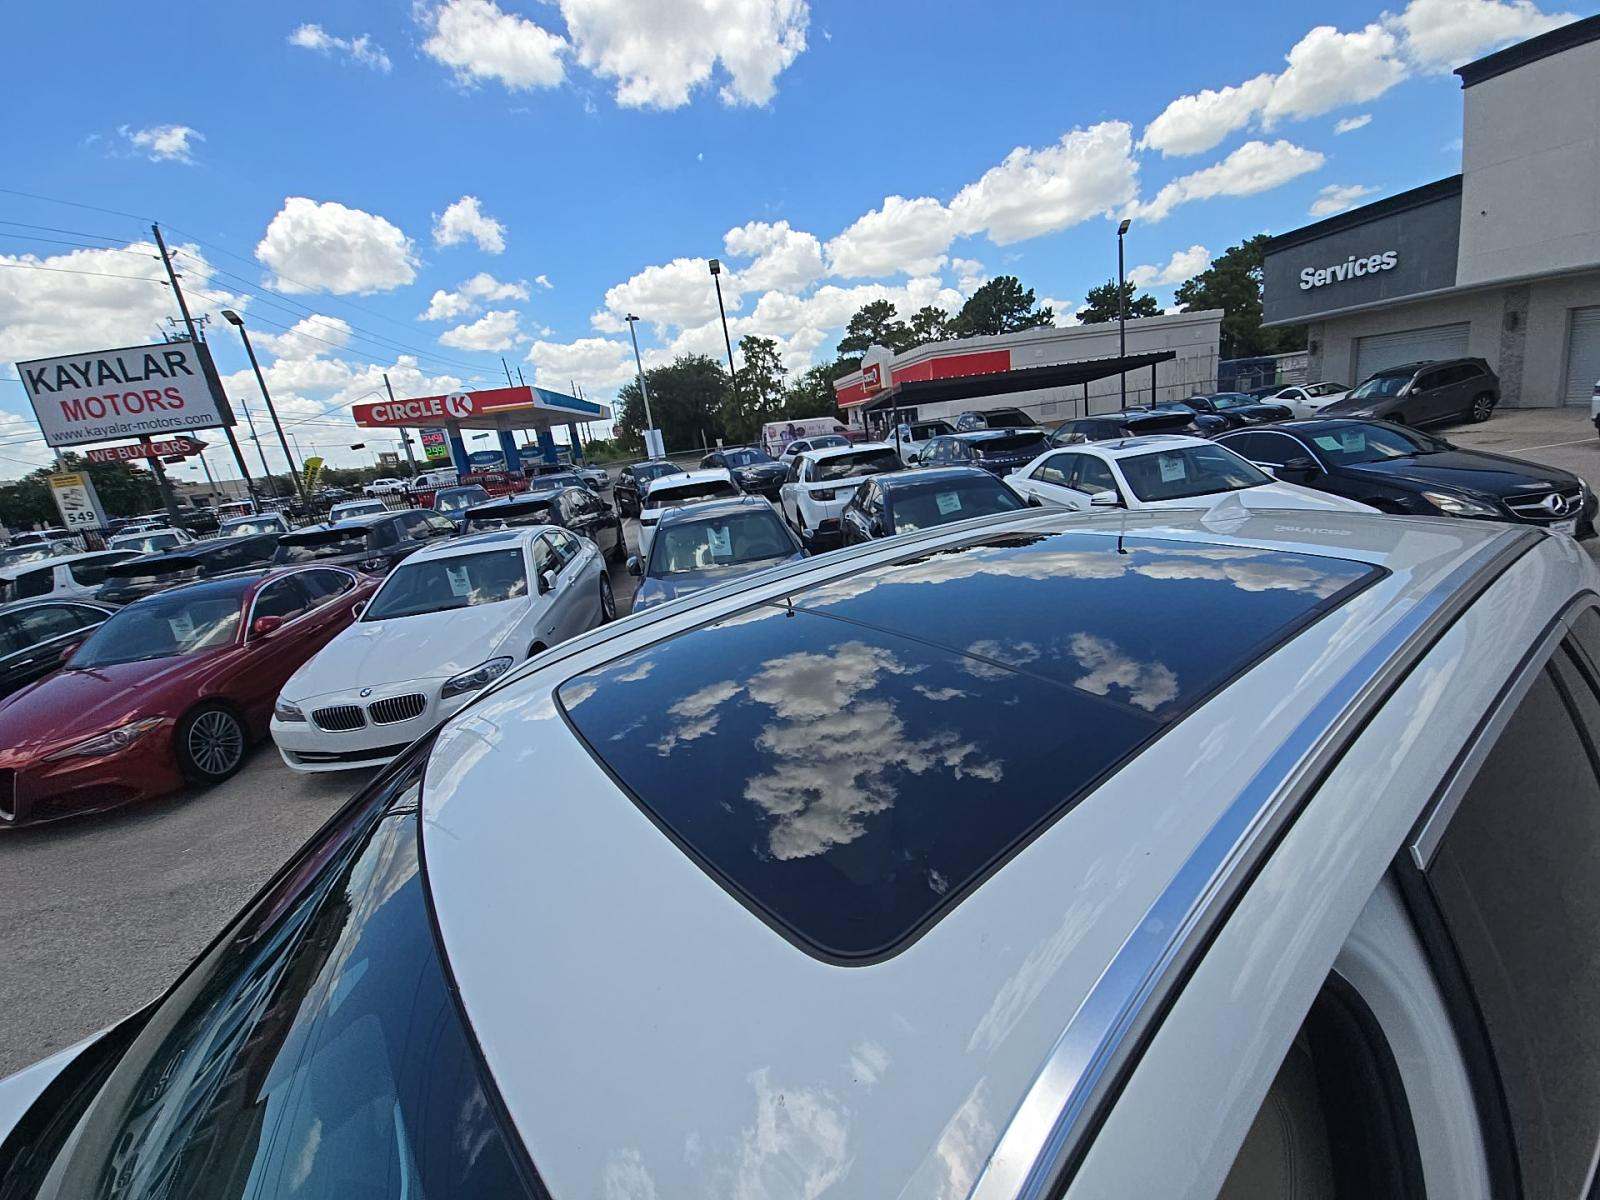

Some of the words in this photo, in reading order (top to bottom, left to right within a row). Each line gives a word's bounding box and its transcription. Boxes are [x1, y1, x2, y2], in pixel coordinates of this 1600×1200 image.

[1299, 250, 1398, 290] Services
[26, 350, 194, 395] KAYALAR
[59, 387, 185, 422] MOTORS
[371, 400, 443, 422] CIRCLE
[452, 395, 472, 417] K
[52, 412, 213, 441] www.kayalar-motors.com
[88, 450, 115, 463] WE
[118, 445, 147, 459] BUY
[150, 439, 191, 457] CARS
[68, 511, 95, 523] 549
